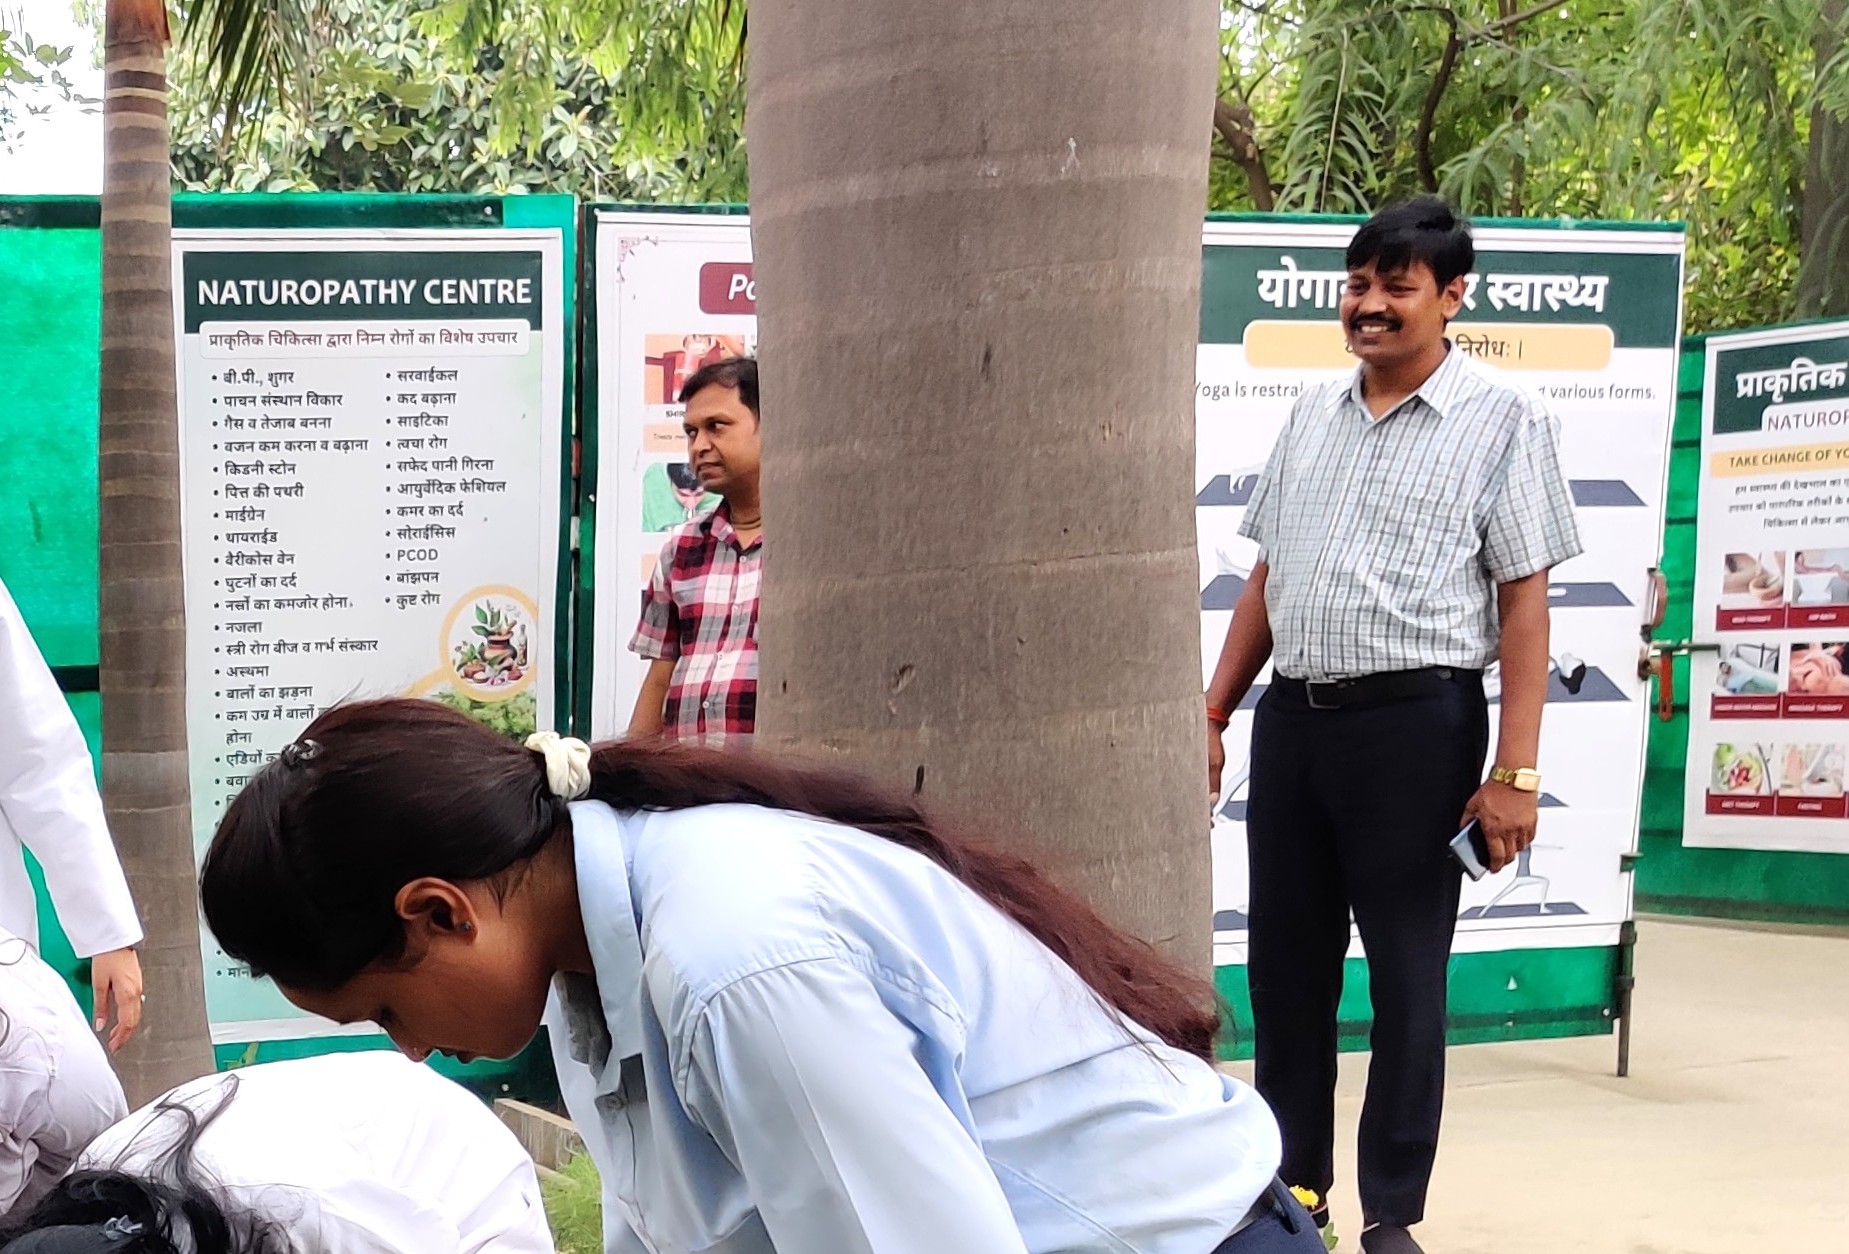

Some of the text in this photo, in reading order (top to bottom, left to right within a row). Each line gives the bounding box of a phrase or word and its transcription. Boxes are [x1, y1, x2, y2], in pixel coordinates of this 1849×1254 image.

[197, 278, 532, 305] NATUROPATHY CENTRE
[1256, 255, 1349, 309] योगा
[1486, 273, 1609, 313] स्वास्थ्य
[208, 329, 519, 350] प्राकृतिक चिकित्सा द्वारा निम्न रोगों का विशेष उपचार
[268, 371, 294, 388] शुगर
[1735, 357, 1849, 403] प्राकृतिक
[223, 391, 343, 407] पाचन संस्थान विकार
[397, 393, 418, 405] कद
[1550, 383, 1605, 399] various
[224, 414, 332, 430] गैस व तेजाब बनना
[397, 412, 449, 427] साइटिका
[224, 441, 255, 453] वजन
[258, 440, 281, 452] कम
[284, 440, 317, 452] करना
[320, 440, 329, 451] व
[397, 434, 448, 450] त्वचा रोग
[432, 456, 458, 472] पानी
[462, 456, 494, 471] गिरना
[1729, 454, 1759, 468] TAKE
[1762, 450, 1811, 466] CHANGE
[1815, 449, 1830, 461] OF
[224, 459, 296, 476] किडनी स्टोन
[225, 481, 304, 498] पित्त की पथरी
[396, 501, 464, 517] कमर का दर्द
[277, 550, 295, 565] वेन
[397, 548, 439, 562] PCOD
[260, 576, 277, 588] का
[280, 572, 298, 588] दर्द
[253, 599, 270, 611] का
[273, 594, 318, 610] कमजोर
[421, 590, 441, 605] रोग
[225, 621, 263, 633] नजला
[250, 640, 269, 655] रोग
[302, 642, 311, 653] व
[338, 637, 379, 652] संस्कार
[226, 684, 256, 700] बालों
[259, 687, 275, 699] का
[226, 729, 252, 746] होना
